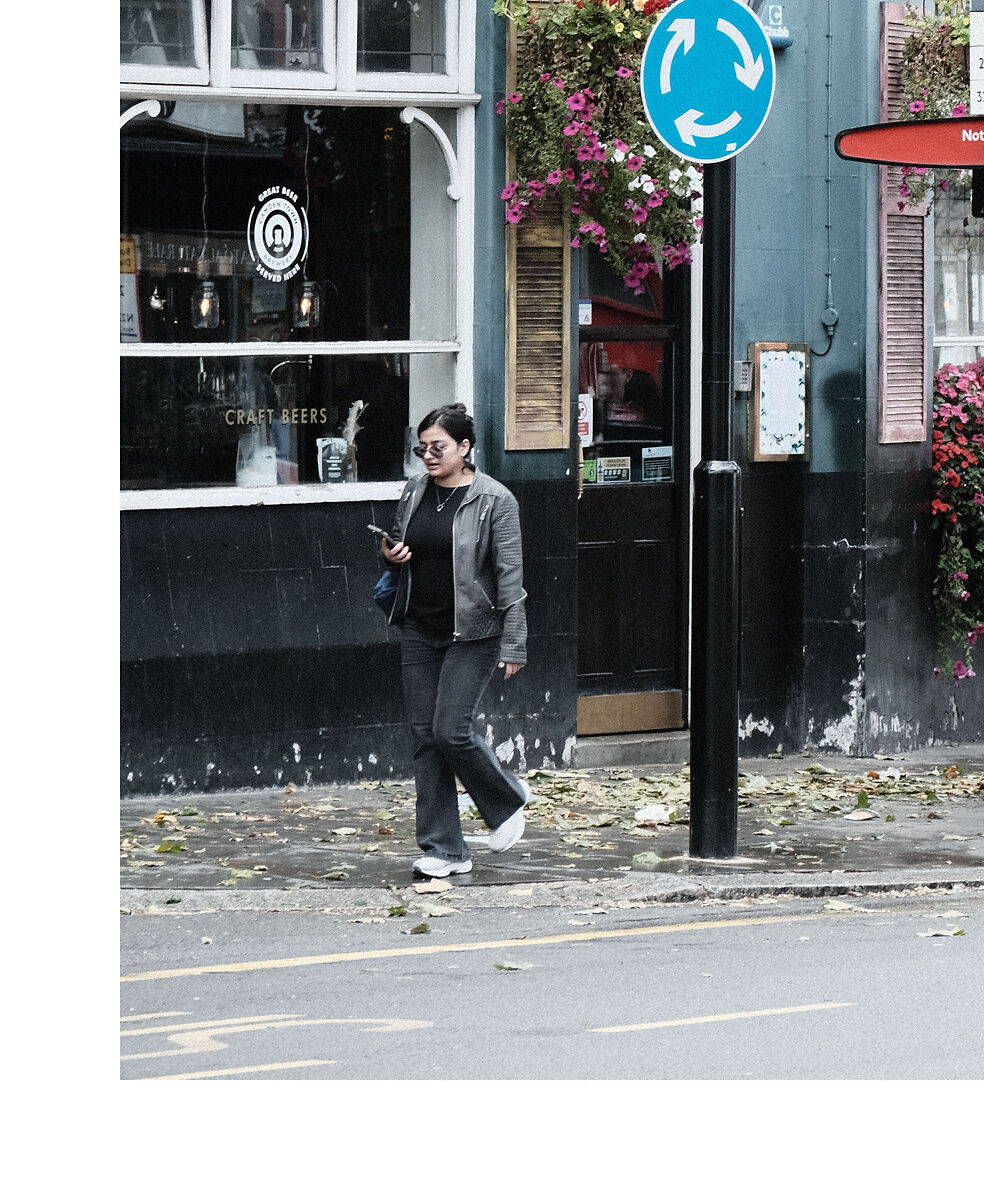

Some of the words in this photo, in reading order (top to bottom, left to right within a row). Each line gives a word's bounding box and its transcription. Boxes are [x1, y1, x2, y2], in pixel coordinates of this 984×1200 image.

[258, 185, 281, 202] GREAT
[281, 186, 299, 203] BEER
[259, 202, 281, 224] CAMDEN
[283, 203, 299, 225] TOWN
[263, 254, 293, 267] BREWERY
[255, 264, 282, 283] SERVED
[283, 263, 301, 281] HERE
[225, 408, 275, 426] CRAFT
[281, 407, 328, 425] BEERS
